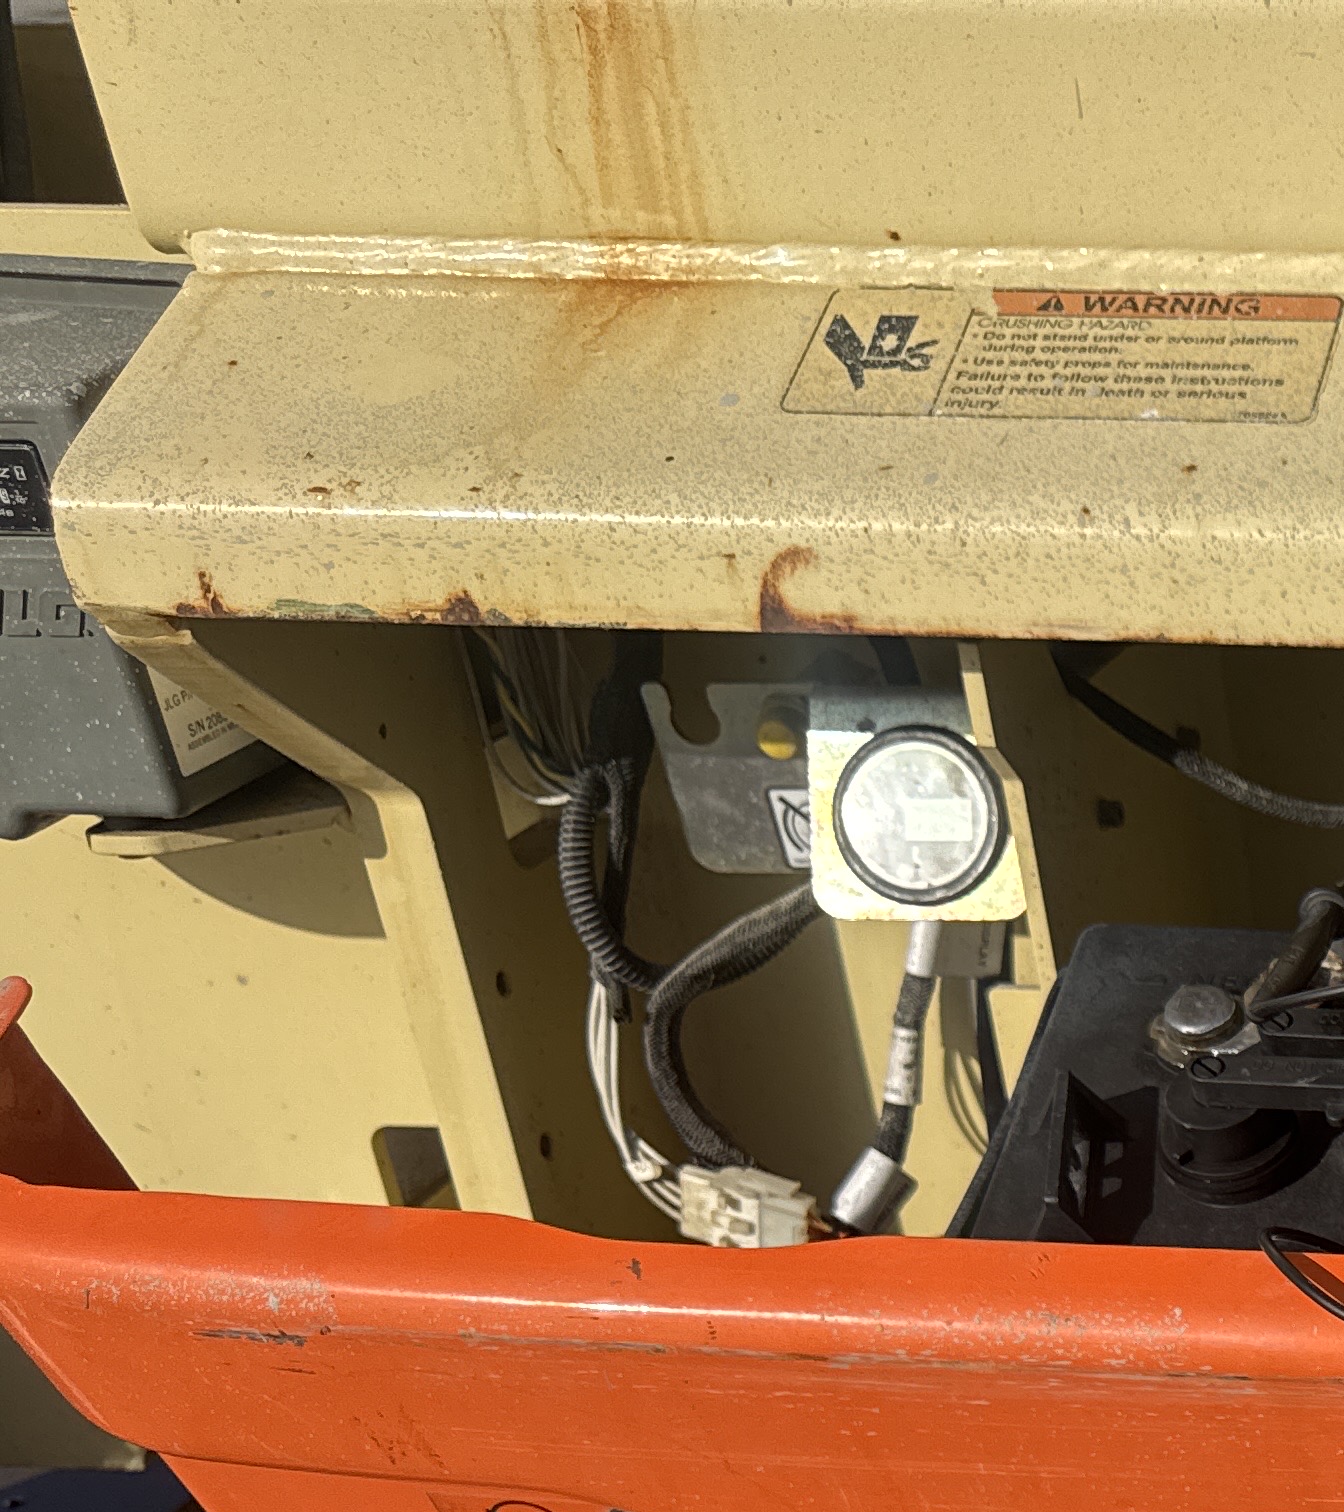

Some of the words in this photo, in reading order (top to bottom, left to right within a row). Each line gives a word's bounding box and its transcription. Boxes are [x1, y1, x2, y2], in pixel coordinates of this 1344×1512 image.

[1084, 295, 1260, 315] WARNING
[978, 317, 1073, 329] CRUSHING
[1080, 319, 1151, 331] HAZARD
[983, 331, 1005, 342] Do
[1011, 331, 1038, 342] not
[1042, 332, 1089, 343] stand
[1094, 333, 1139, 344] under
[1145, 335, 1161, 344] or
[1167, 335, 1226, 345] around
[1230, 335, 1299, 347] platform
[982, 343, 1036, 355] during
[973, 356, 1005, 367] Use
[1009, 358, 1061, 370] safety
[1064, 360, 1112, 370] props
[1117, 359, 1140, 369] for
[955, 371, 1021, 382] Failure
[1027, 372, 1045, 382] to
[1052, 372, 1108, 384] follow
[1114, 373, 1166, 385] these
[951, 384, 1004, 396] could
[1009, 385, 1064, 397] result
[1068, 387, 1087, 397] in
[1151, 390, 1170, 399] or
[1176, 390, 1248, 400] serious
